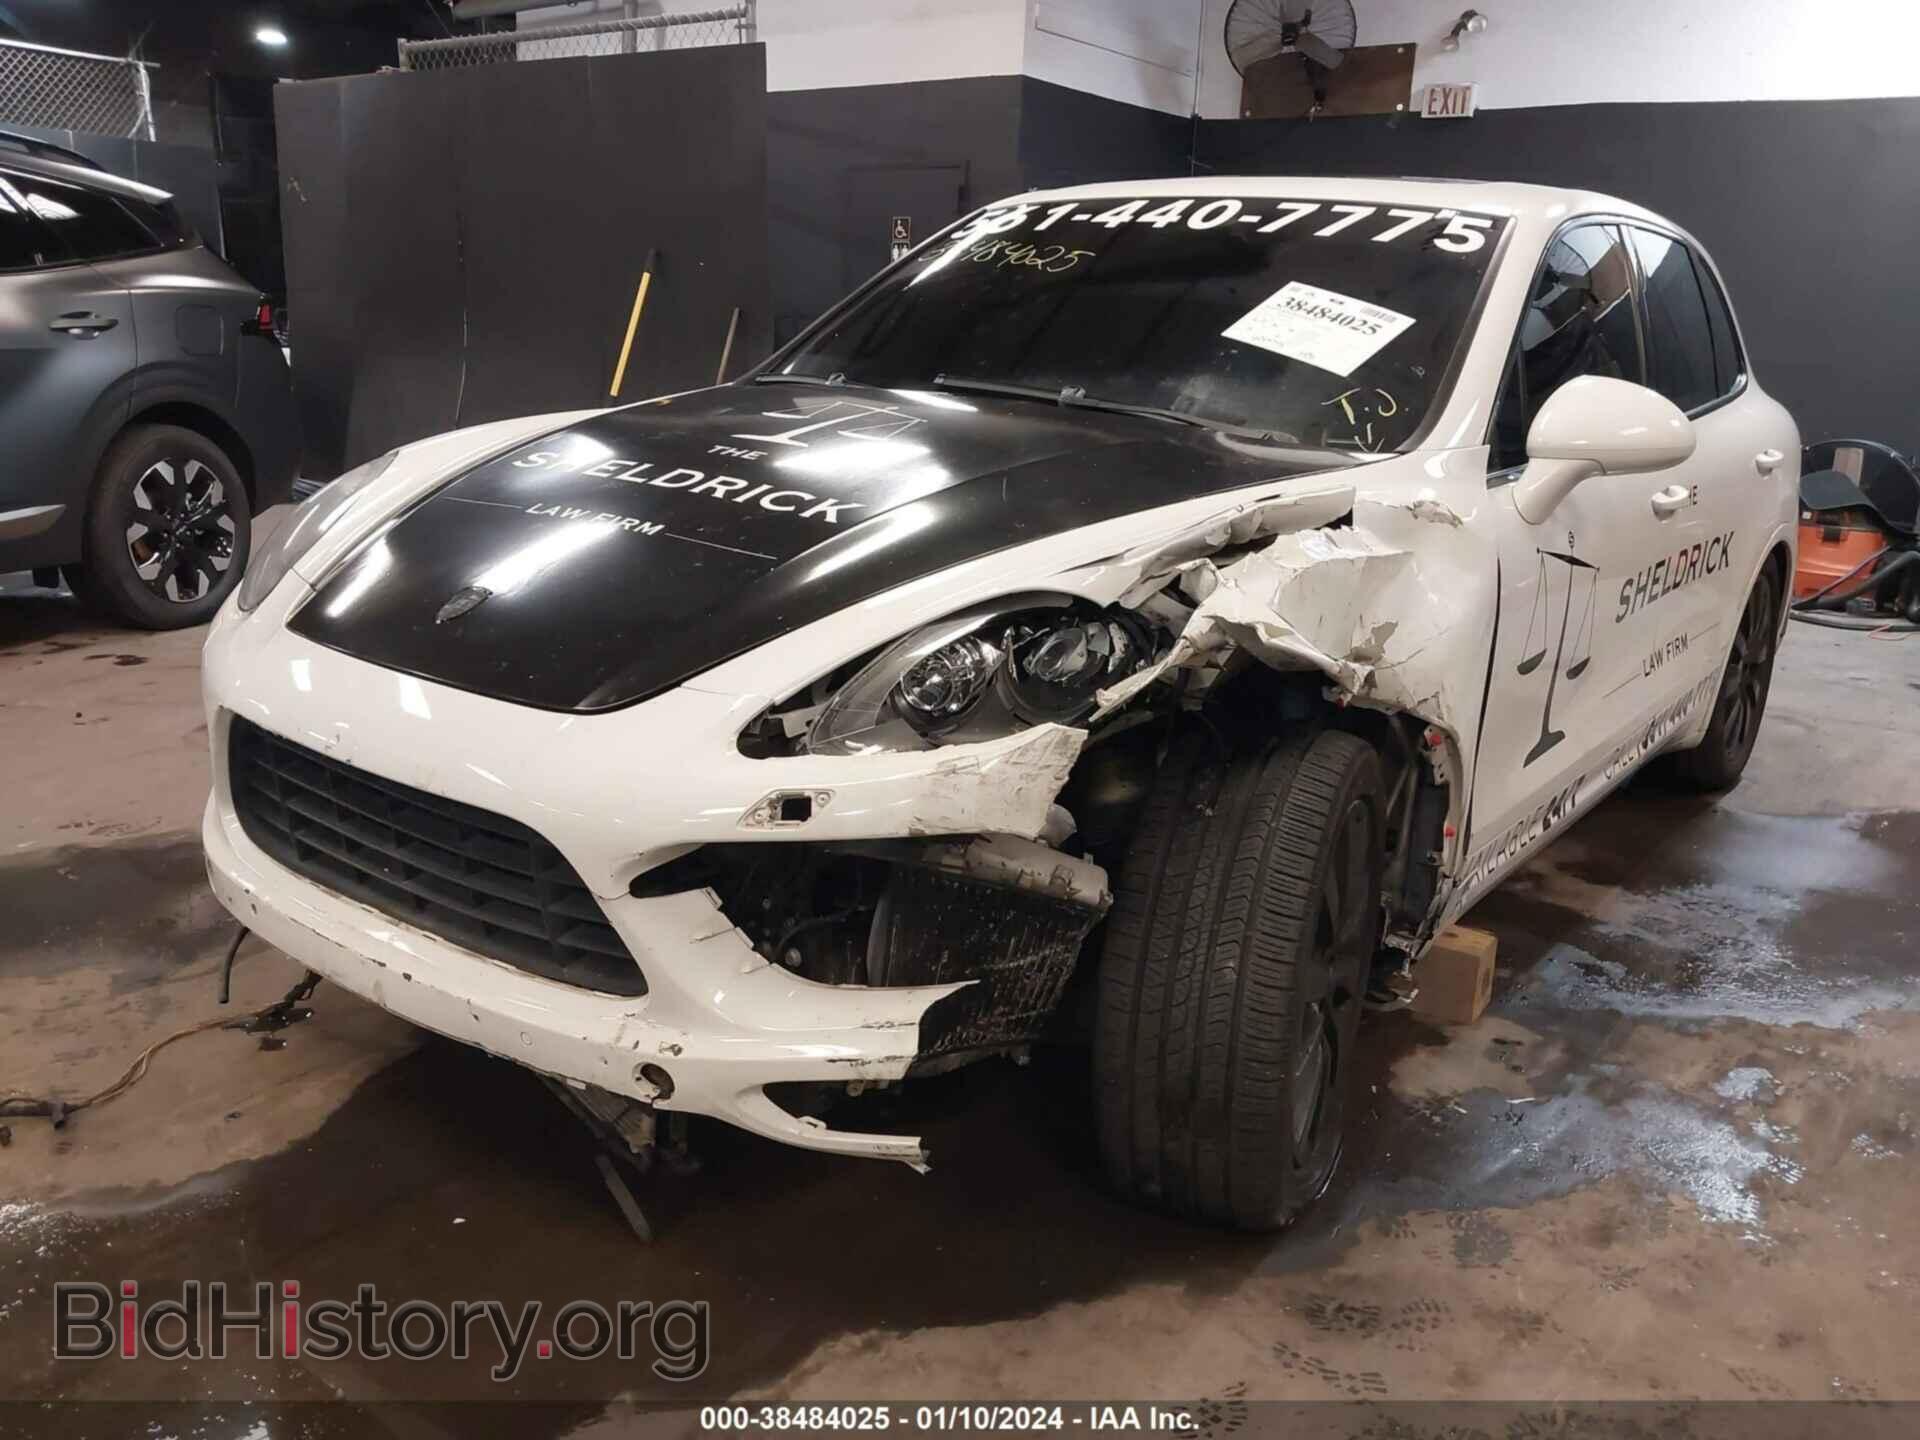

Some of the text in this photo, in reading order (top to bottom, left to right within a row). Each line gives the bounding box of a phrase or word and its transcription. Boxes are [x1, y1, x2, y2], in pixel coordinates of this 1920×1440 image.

[1427, 86, 1471, 115] EXIT
[1276, 296, 1384, 337] 38484025
[706, 444, 768, 460] THE
[525, 503, 665, 536] LAW FIRM
[1615, 530, 1735, 624] SHELDRICK
[1642, 633, 1689, 677] LAW FIRM
